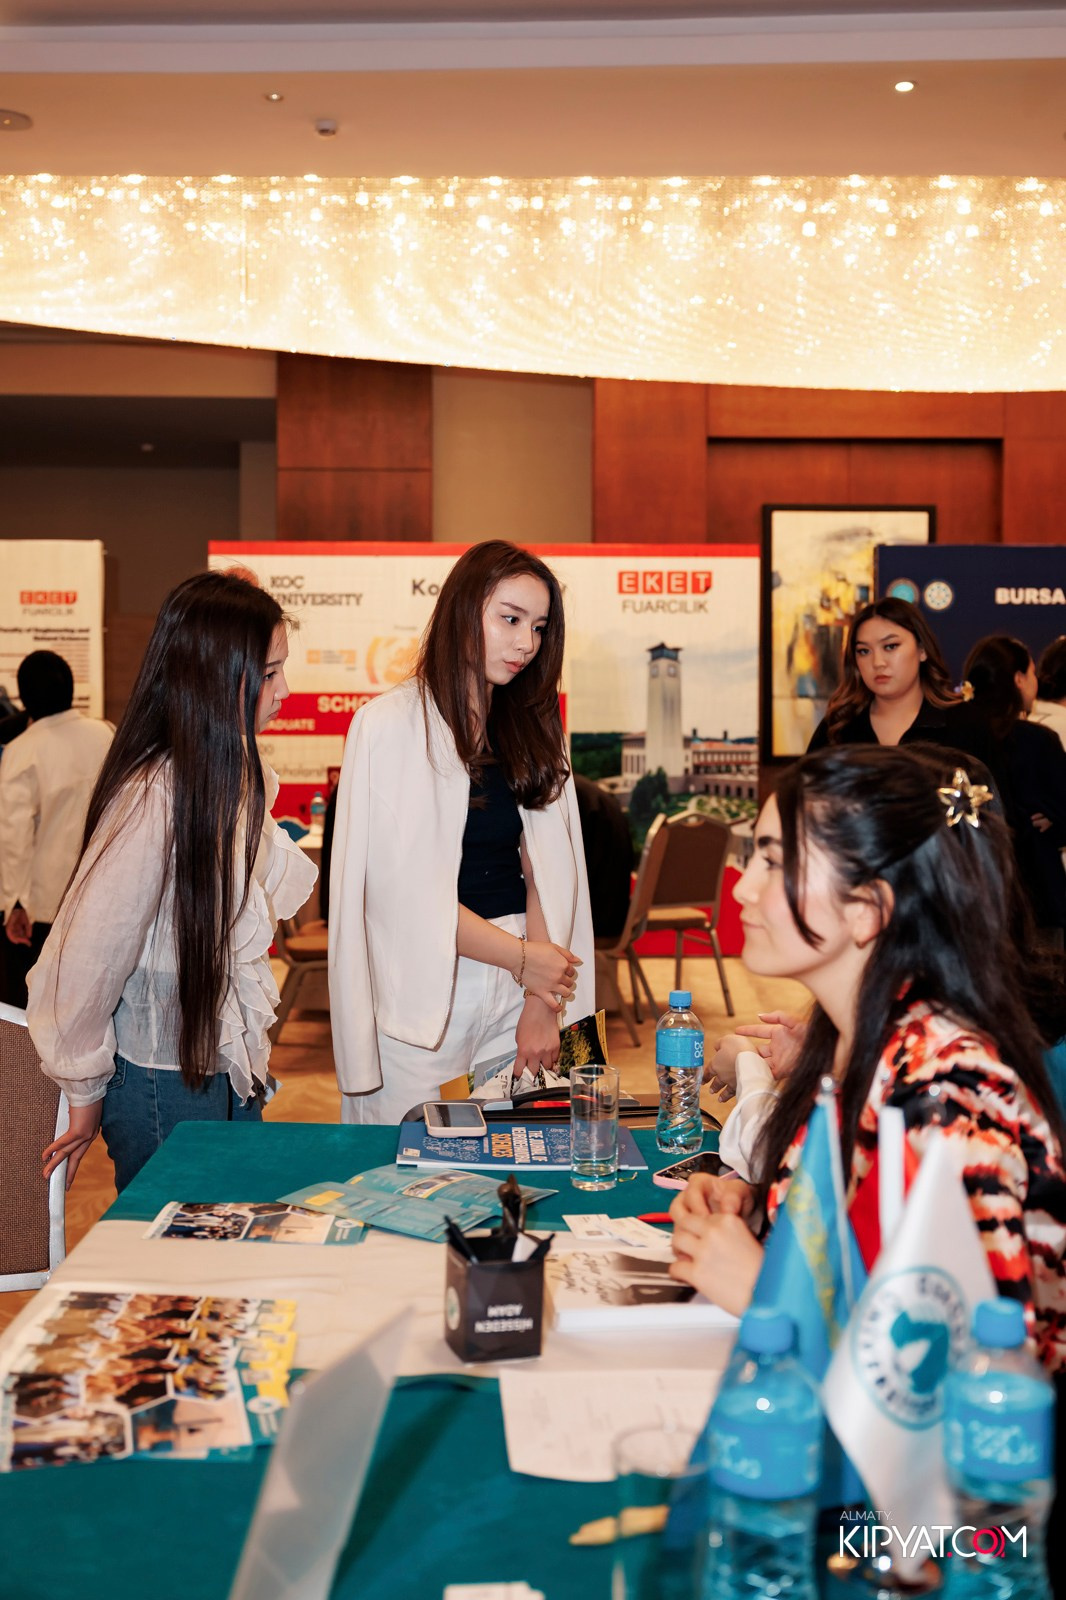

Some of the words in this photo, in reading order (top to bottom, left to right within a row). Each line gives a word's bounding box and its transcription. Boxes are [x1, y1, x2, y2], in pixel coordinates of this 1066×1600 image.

[411, 579, 441, 596] Ko
[618, 571, 712, 594] EKET
[995, 587, 1066, 605] BURSA
[266, 718, 315, 731] ADUATE
